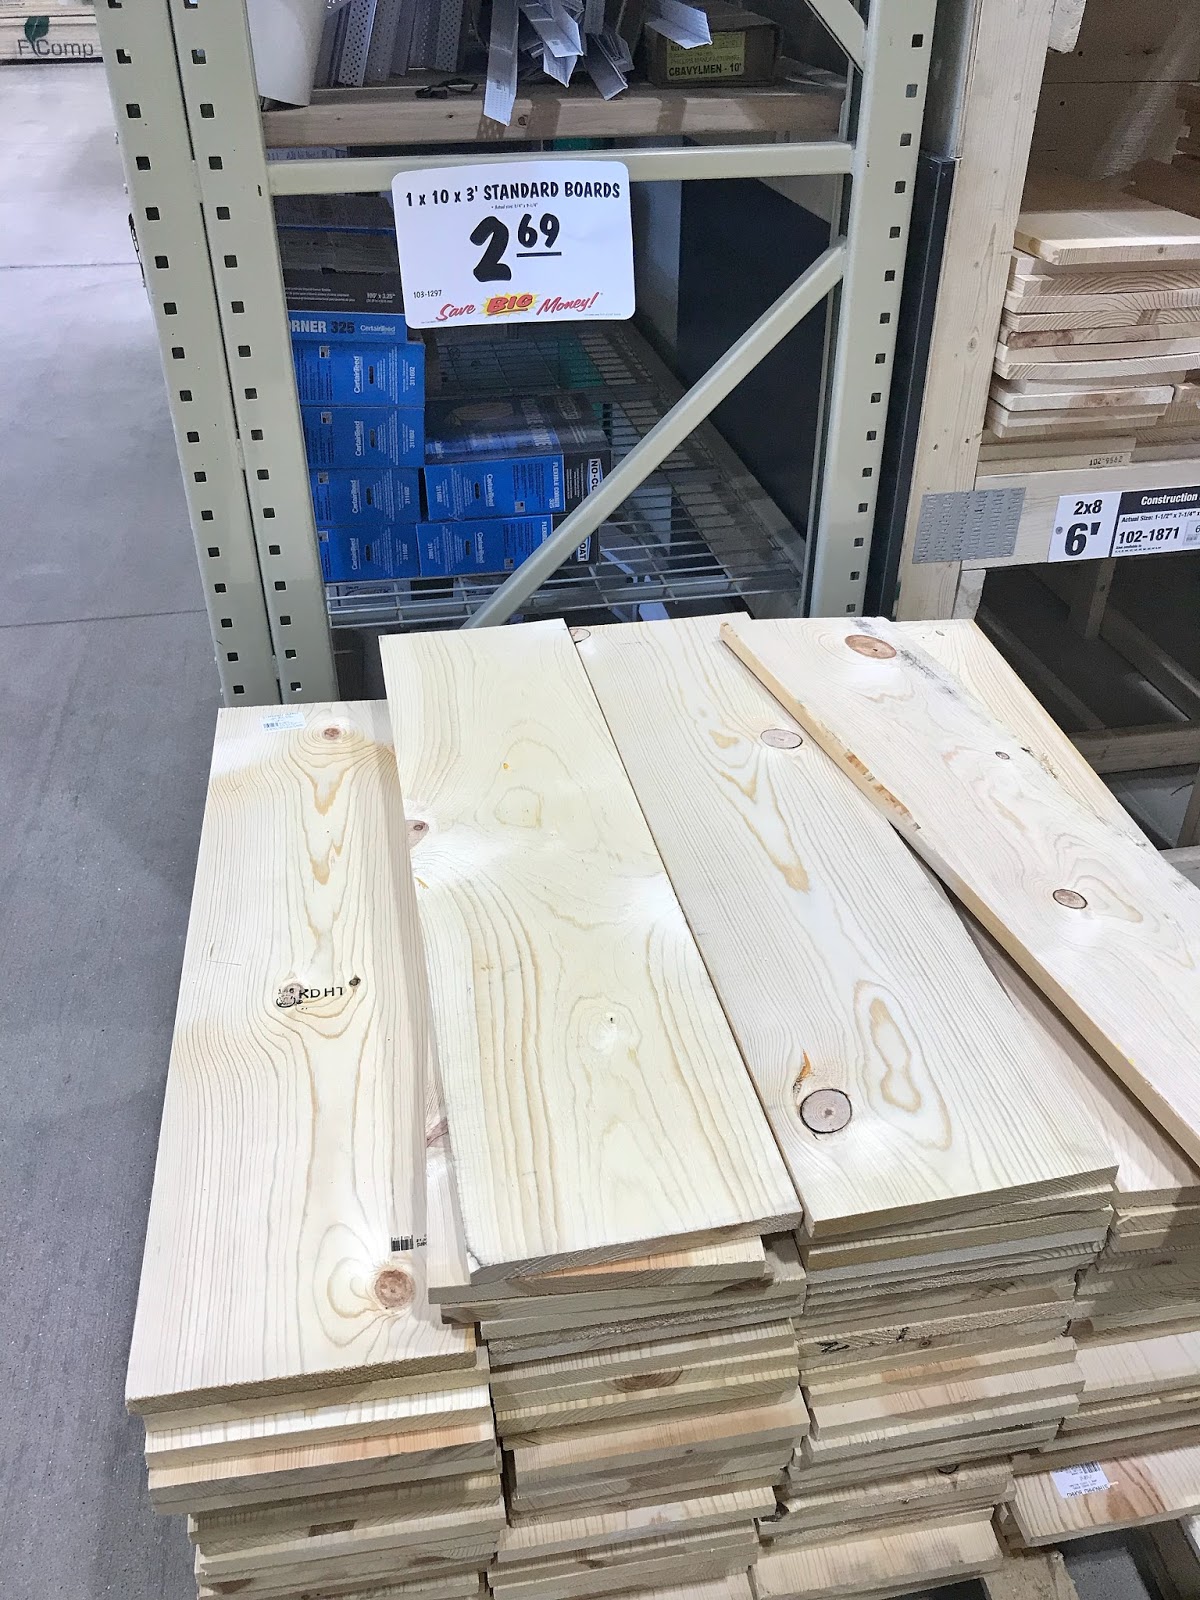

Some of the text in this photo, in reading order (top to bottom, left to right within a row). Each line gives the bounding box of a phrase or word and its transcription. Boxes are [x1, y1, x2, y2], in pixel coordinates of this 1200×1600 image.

[406, 181, 621, 207] 1 x 10 x 3' STANDARD BOARDS
[413, 289, 442, 299] 103-1297
[435, 291, 600, 322] Save BIG Money!
[289, 319, 355, 334] RNER 325
[360, 324, 396, 333] CertainTeed
[353, 355, 361, 394] CertainTeed
[353, 420, 362, 457] CertainTeed
[350, 479, 359, 514] CertainTeed
[1140, 492, 1198, 506] Construction
[1073, 499, 1103, 516] 2x8
[1121, 515, 1140, 523] Actual
[1064, 521, 1102, 557] 6'
[1118, 526, 1180, 544] 102-1871
[349, 537, 358, 570] CertainTeed
[579, 543, 587, 560] OAT
